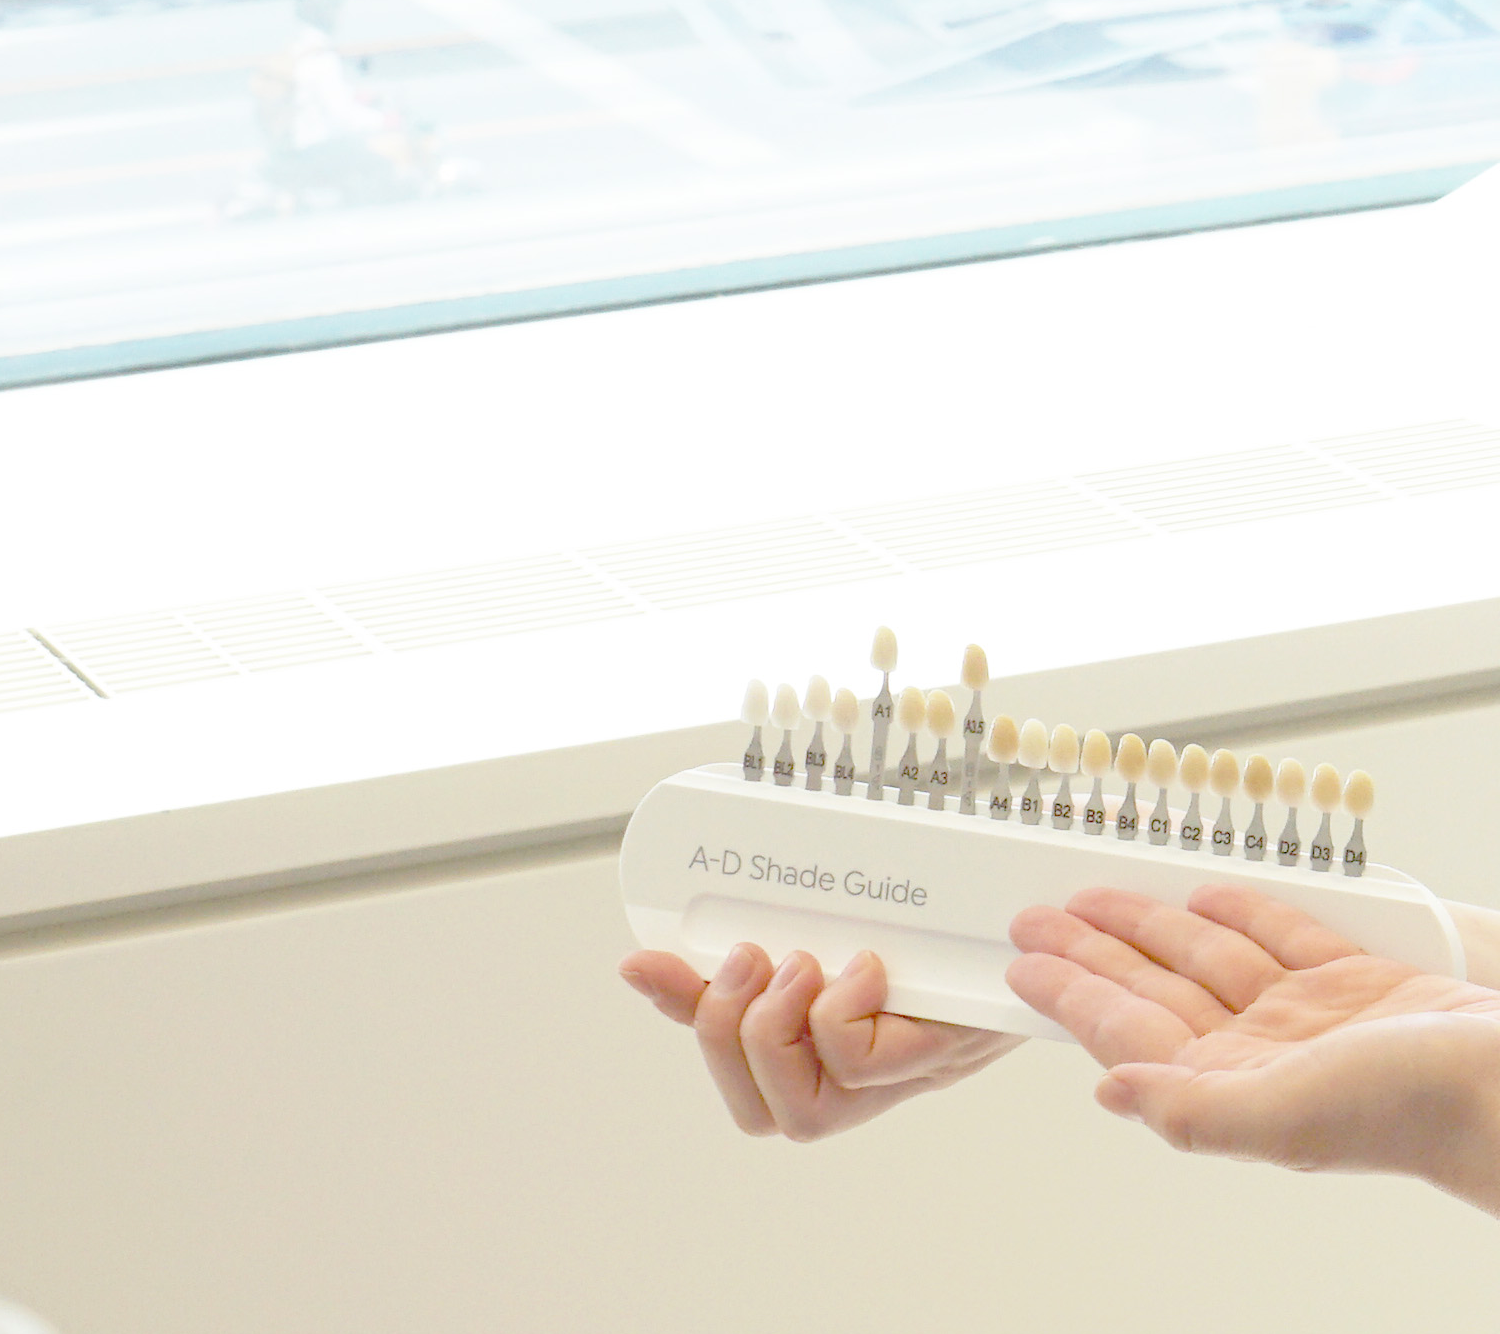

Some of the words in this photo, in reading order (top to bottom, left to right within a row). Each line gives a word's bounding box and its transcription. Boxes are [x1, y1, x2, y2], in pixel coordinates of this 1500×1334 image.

[874, 704, 891, 718] A1
[744, 754, 763, 769] BL1
[806, 751, 825, 767] BL3
[773, 760, 794, 776] BL2
[834, 764, 853, 780] BL4
[901, 766, 919, 781] A2
[930, 770, 948, 785] A3
[990, 796, 1008, 812] A4
[1021, 798, 1039, 813] B1
[1053, 803, 1071, 818] B2
[1086, 809, 1103, 824] B3
[1118, 816, 1135, 831] B4
[1151, 819, 1168, 834] C1
[1182, 826, 1200, 841] C2
[1212, 830, 1231, 845] C3
[1245, 835, 1263, 850] C4
[1279, 840, 1298, 856] D2
[1312, 845, 1330, 861] D3
[1345, 849, 1363, 865] D4
[689, 845, 742, 876] A-D
[748, 854, 835, 892] Shade
[843, 870, 928, 907] Guide
